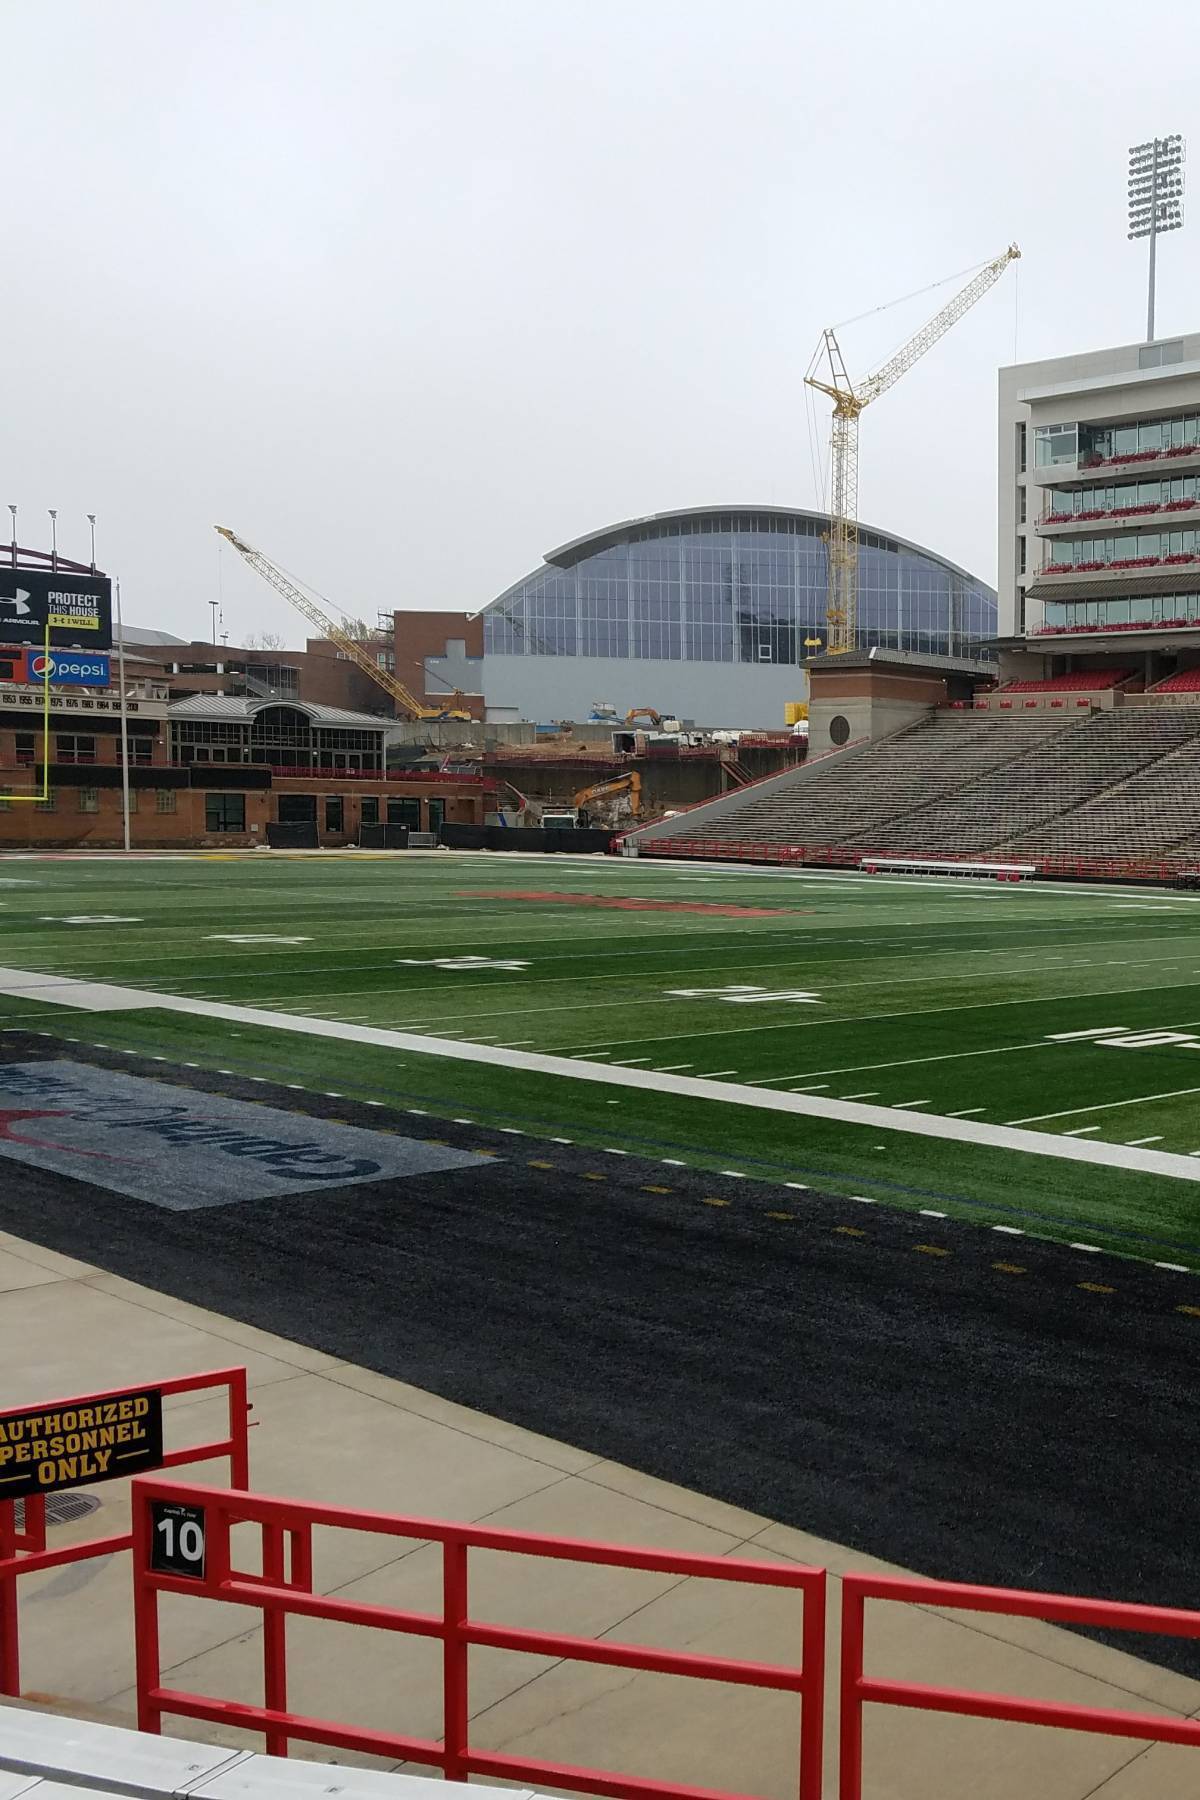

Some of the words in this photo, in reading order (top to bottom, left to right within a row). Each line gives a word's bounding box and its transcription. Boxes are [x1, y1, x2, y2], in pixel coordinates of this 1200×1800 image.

[47, 591, 99, 607] PROTECT
[48, 604, 68, 615] THIS
[58, 663, 104, 678] pepsi
[661, 985, 822, 1003] 20
[0, 1421, 146, 1466] PERSONNEL
[38, 1449, 112, 1485] ONLY
[157, 1518, 204, 1562] 10
